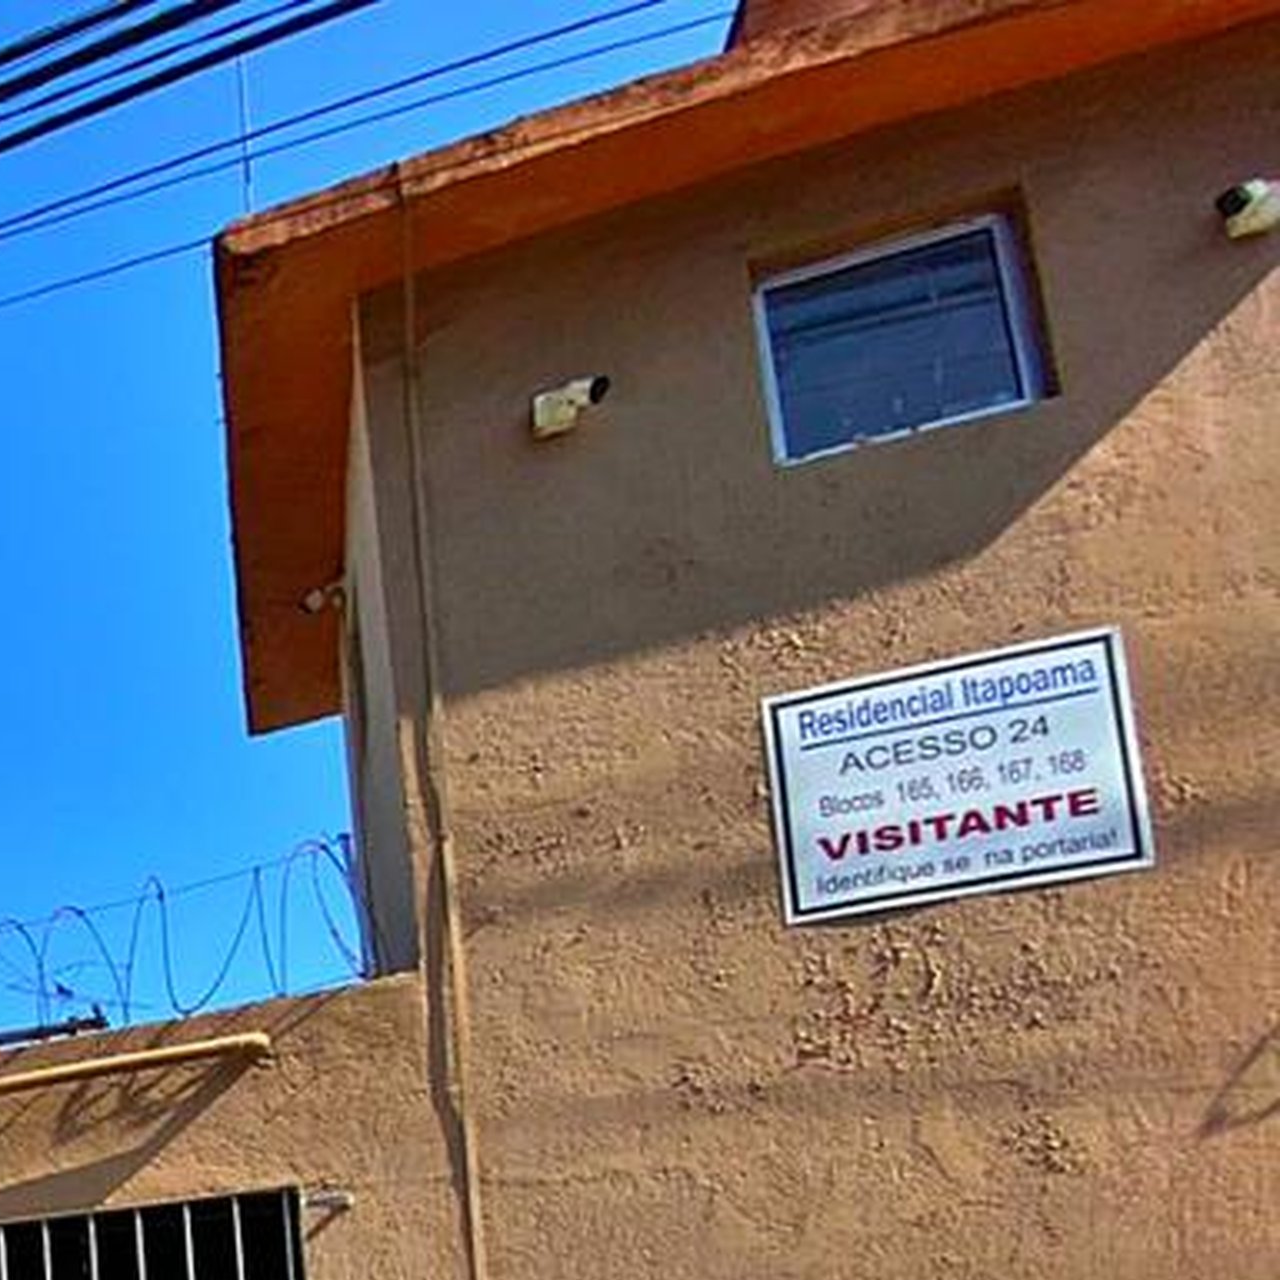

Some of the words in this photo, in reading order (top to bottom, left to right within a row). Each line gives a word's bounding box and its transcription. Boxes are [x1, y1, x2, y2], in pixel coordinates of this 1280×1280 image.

[798, 681, 954, 740] Residencial
[960, 658, 1096, 707] Itapoama
[839, 724, 998, 775] ACESSO
[1007, 714, 1049, 744] 24
[819, 789, 885, 818] Blocos
[1047, 748, 1085, 774] 168
[816, 787, 1100, 861] VISITANTE
[941, 855, 971, 874] se
[984, 848, 1014, 867] na
